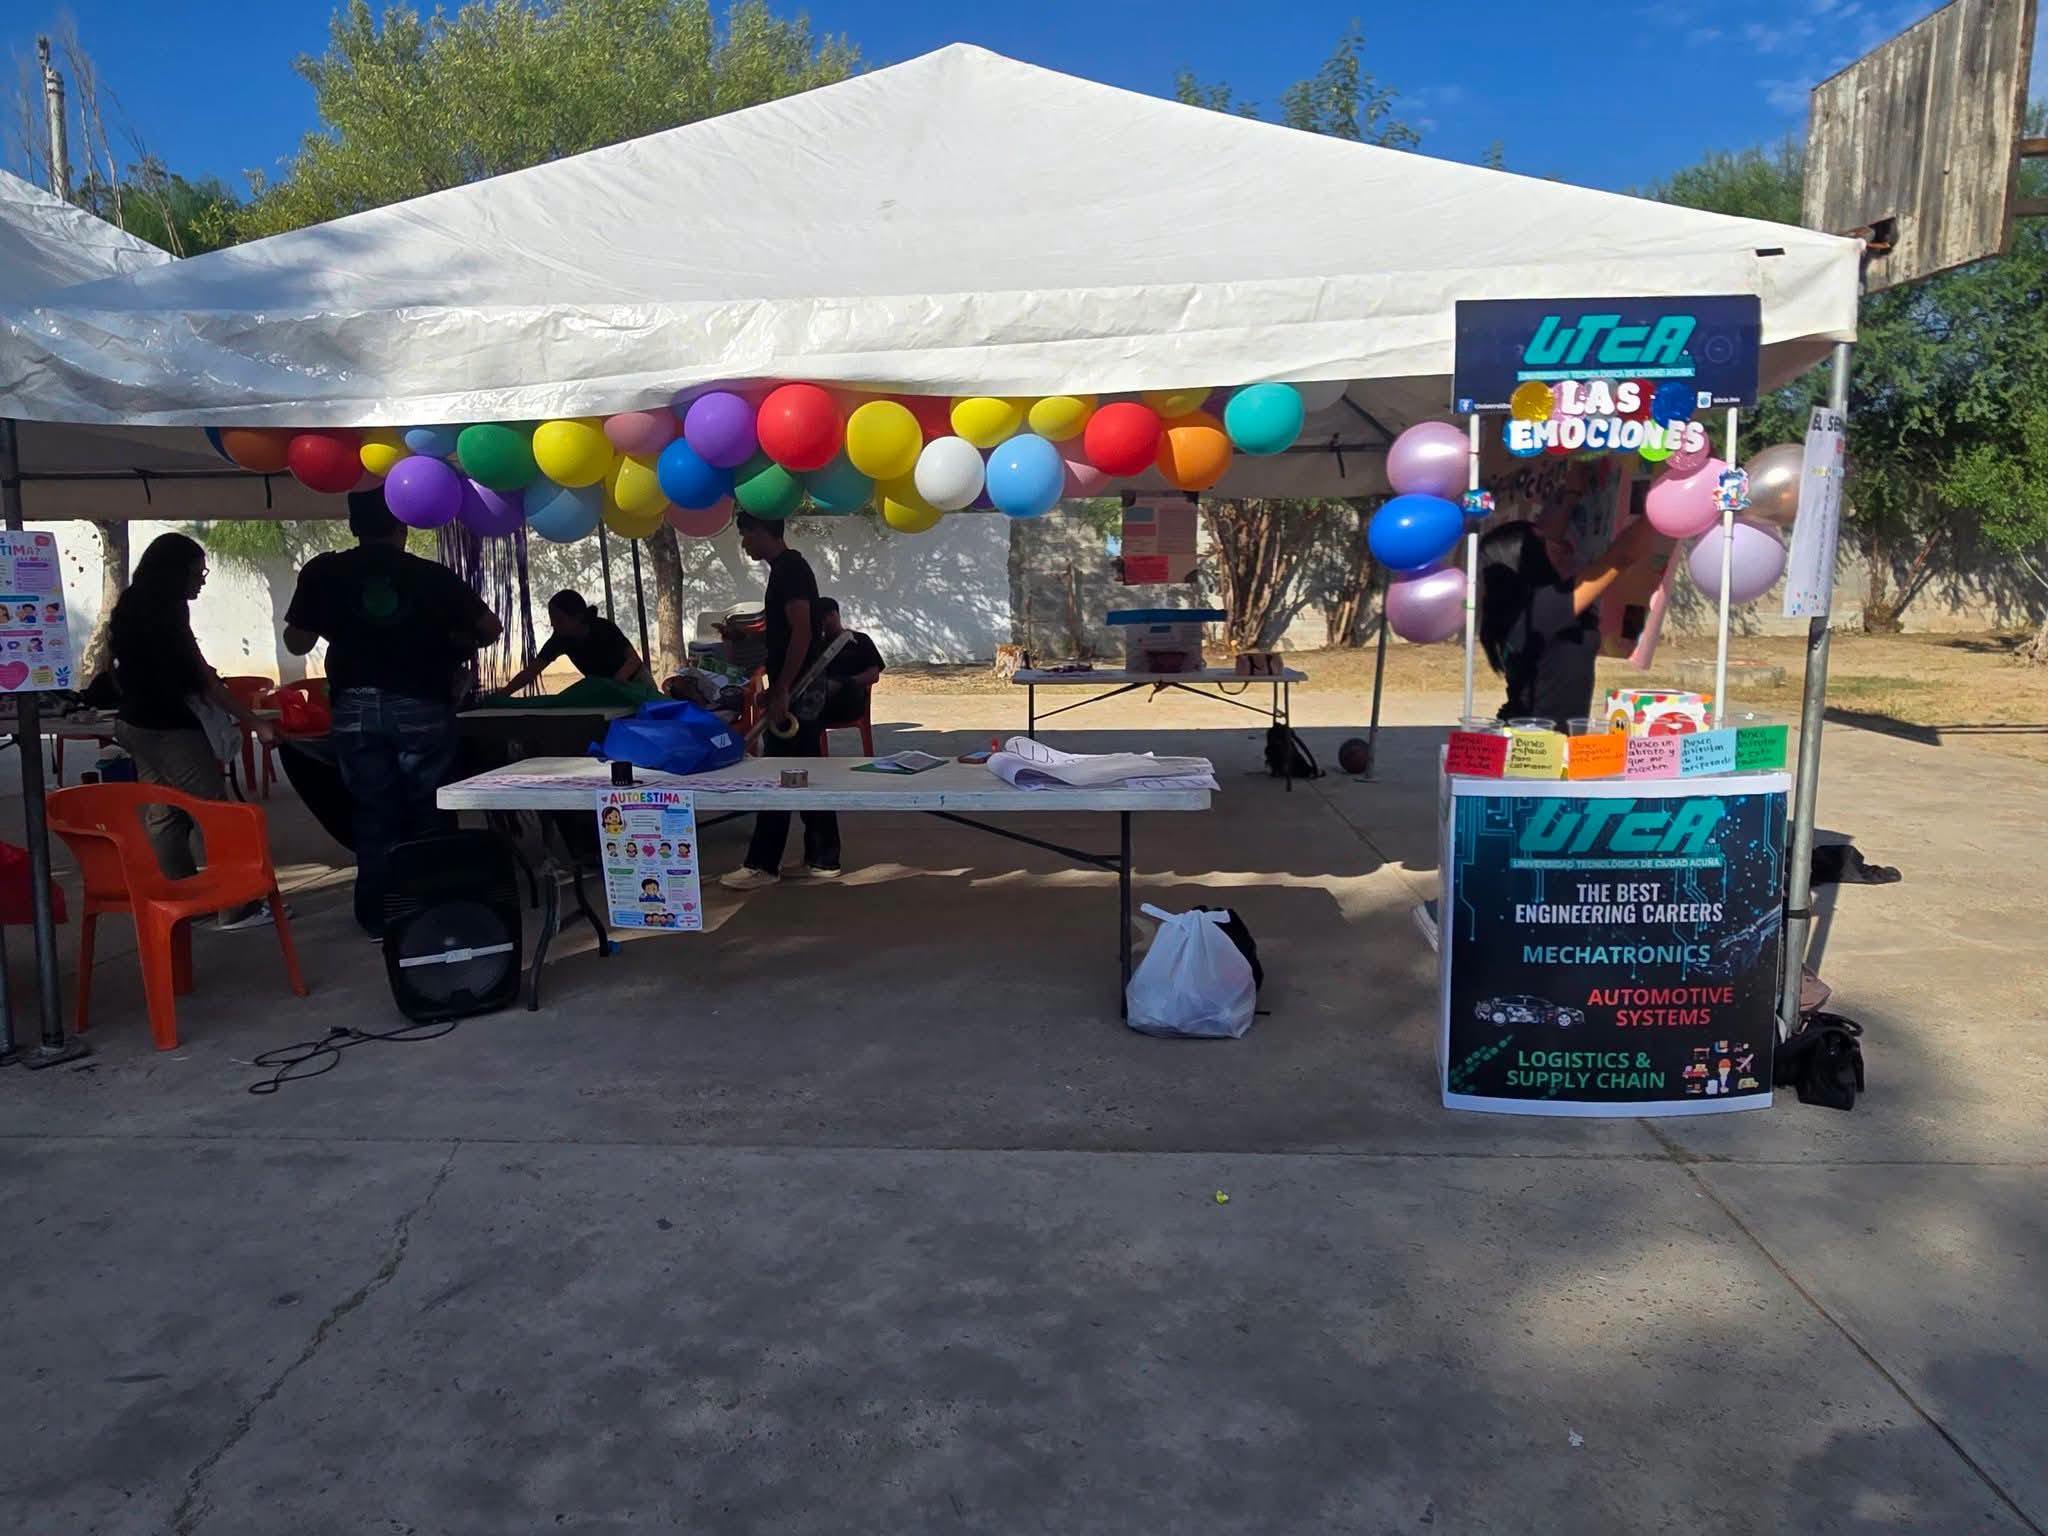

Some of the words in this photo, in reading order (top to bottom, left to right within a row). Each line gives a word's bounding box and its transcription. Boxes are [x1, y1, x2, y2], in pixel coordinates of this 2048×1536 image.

[1561, 380, 1641, 415] LAS
[1508, 419, 1705, 453] EMOCIONES
[1629, 739, 1660, 749] Busco
[1682, 738, 1712, 748] Busco
[610, 791, 680, 805] AUTOESTIMA
[1577, 884, 1613, 902] THE
[1617, 883, 1660, 902] BEST
[1515, 904, 1636, 924] ENGINEERING
[1643, 903, 1723, 923] CAREERS
[1523, 945, 1711, 964] MECHATRONICS
[1587, 986, 1734, 1006] AUTOMOTIVE
[1616, 1008, 1711, 1027] SYSTEMS
[1518, 1050, 1629, 1069] LOGISTICS
[1635, 1052, 1651, 1069] &
[1506, 1070, 1592, 1089] SUPPLY
[1597, 1070, 1665, 1089] CHAIN
